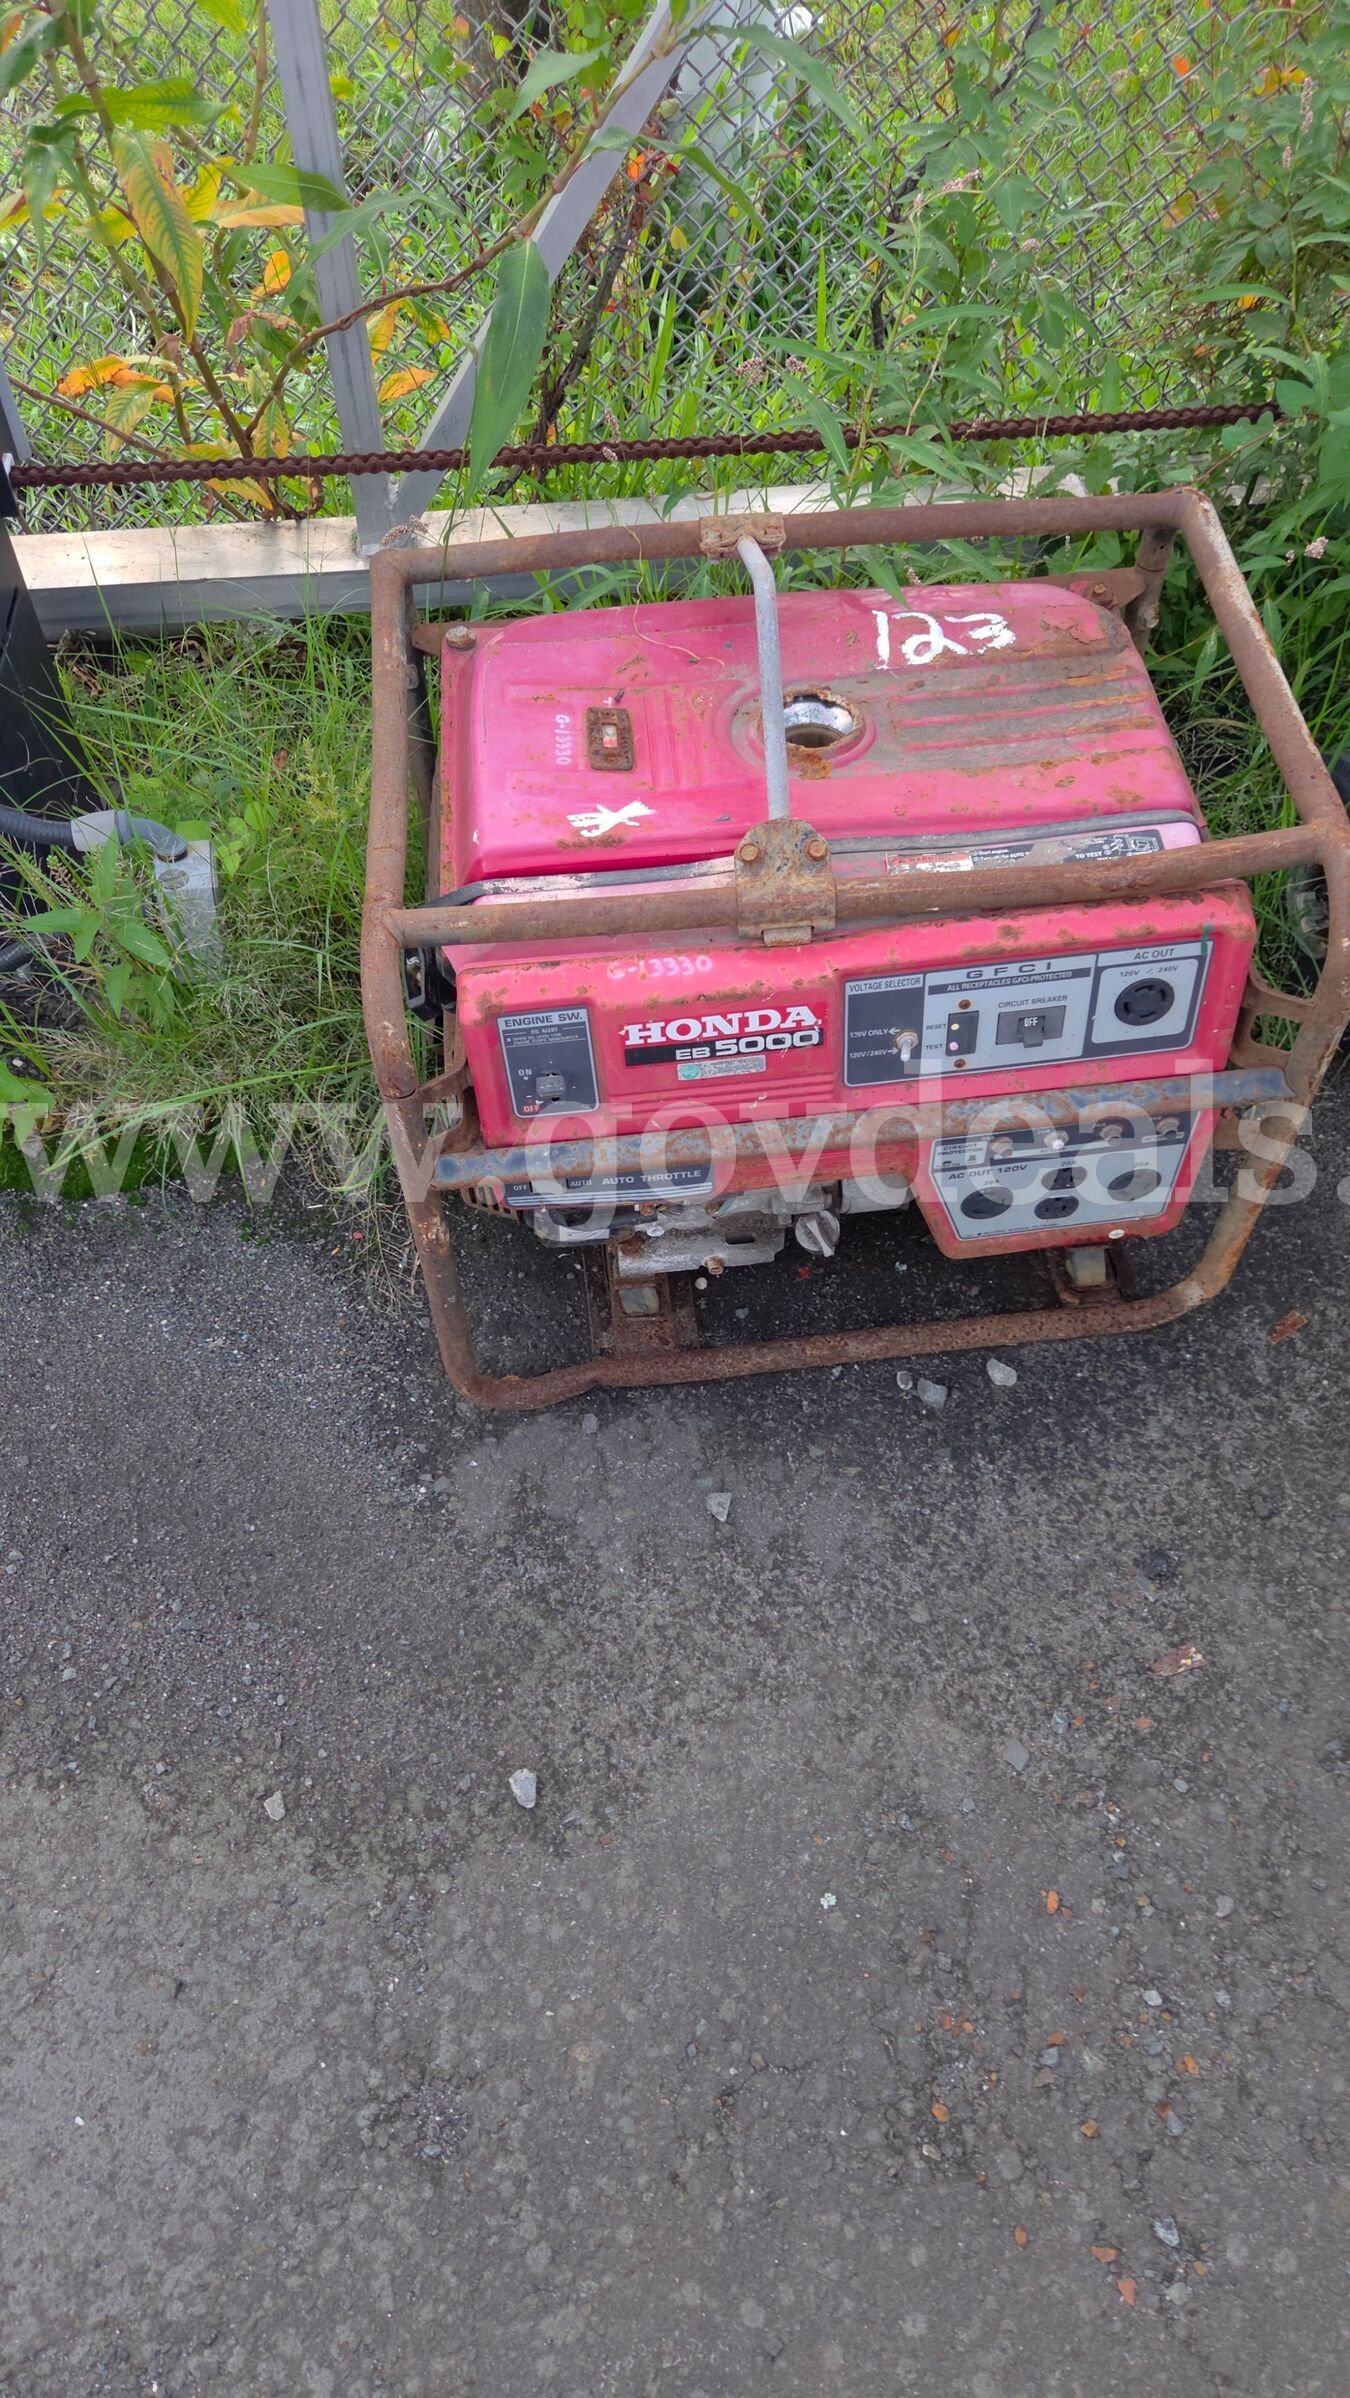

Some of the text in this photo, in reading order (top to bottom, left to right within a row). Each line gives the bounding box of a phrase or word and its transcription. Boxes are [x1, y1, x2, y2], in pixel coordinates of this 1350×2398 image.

[872, 609, 1017, 670] 123
[1086, 851, 1103, 859] TEST
[1133, 948, 1175, 961] AC OUT
[849, 977, 921, 993] VOLTAGE SELECTOR
[946, 970, 1073, 992] ALL RECEPTACLES GFCI-PROTECTED
[998, 994, 1068, 1009] CIRCUIT BREAKER
[504, 1011, 583, 1028] ENGINE SW.
[624, 1004, 823, 1046] HONDA
[1023, 1016, 1039, 1027] OFF
[868, 1027, 889, 1037] ONLY
[925, 1043, 944, 1051] TEST
[517, 1068, 532, 1077] ON
[523, 1104, 540, 1113] OFF
[601, 1169, 702, 1186] AUTO THROTTLE
[948, 1172, 966, 1181] AC
[997, 1164, 1029, 1174] 120V
[513, 1183, 527, 1192] OFF
[570, 1179, 593, 1188] AUTO
